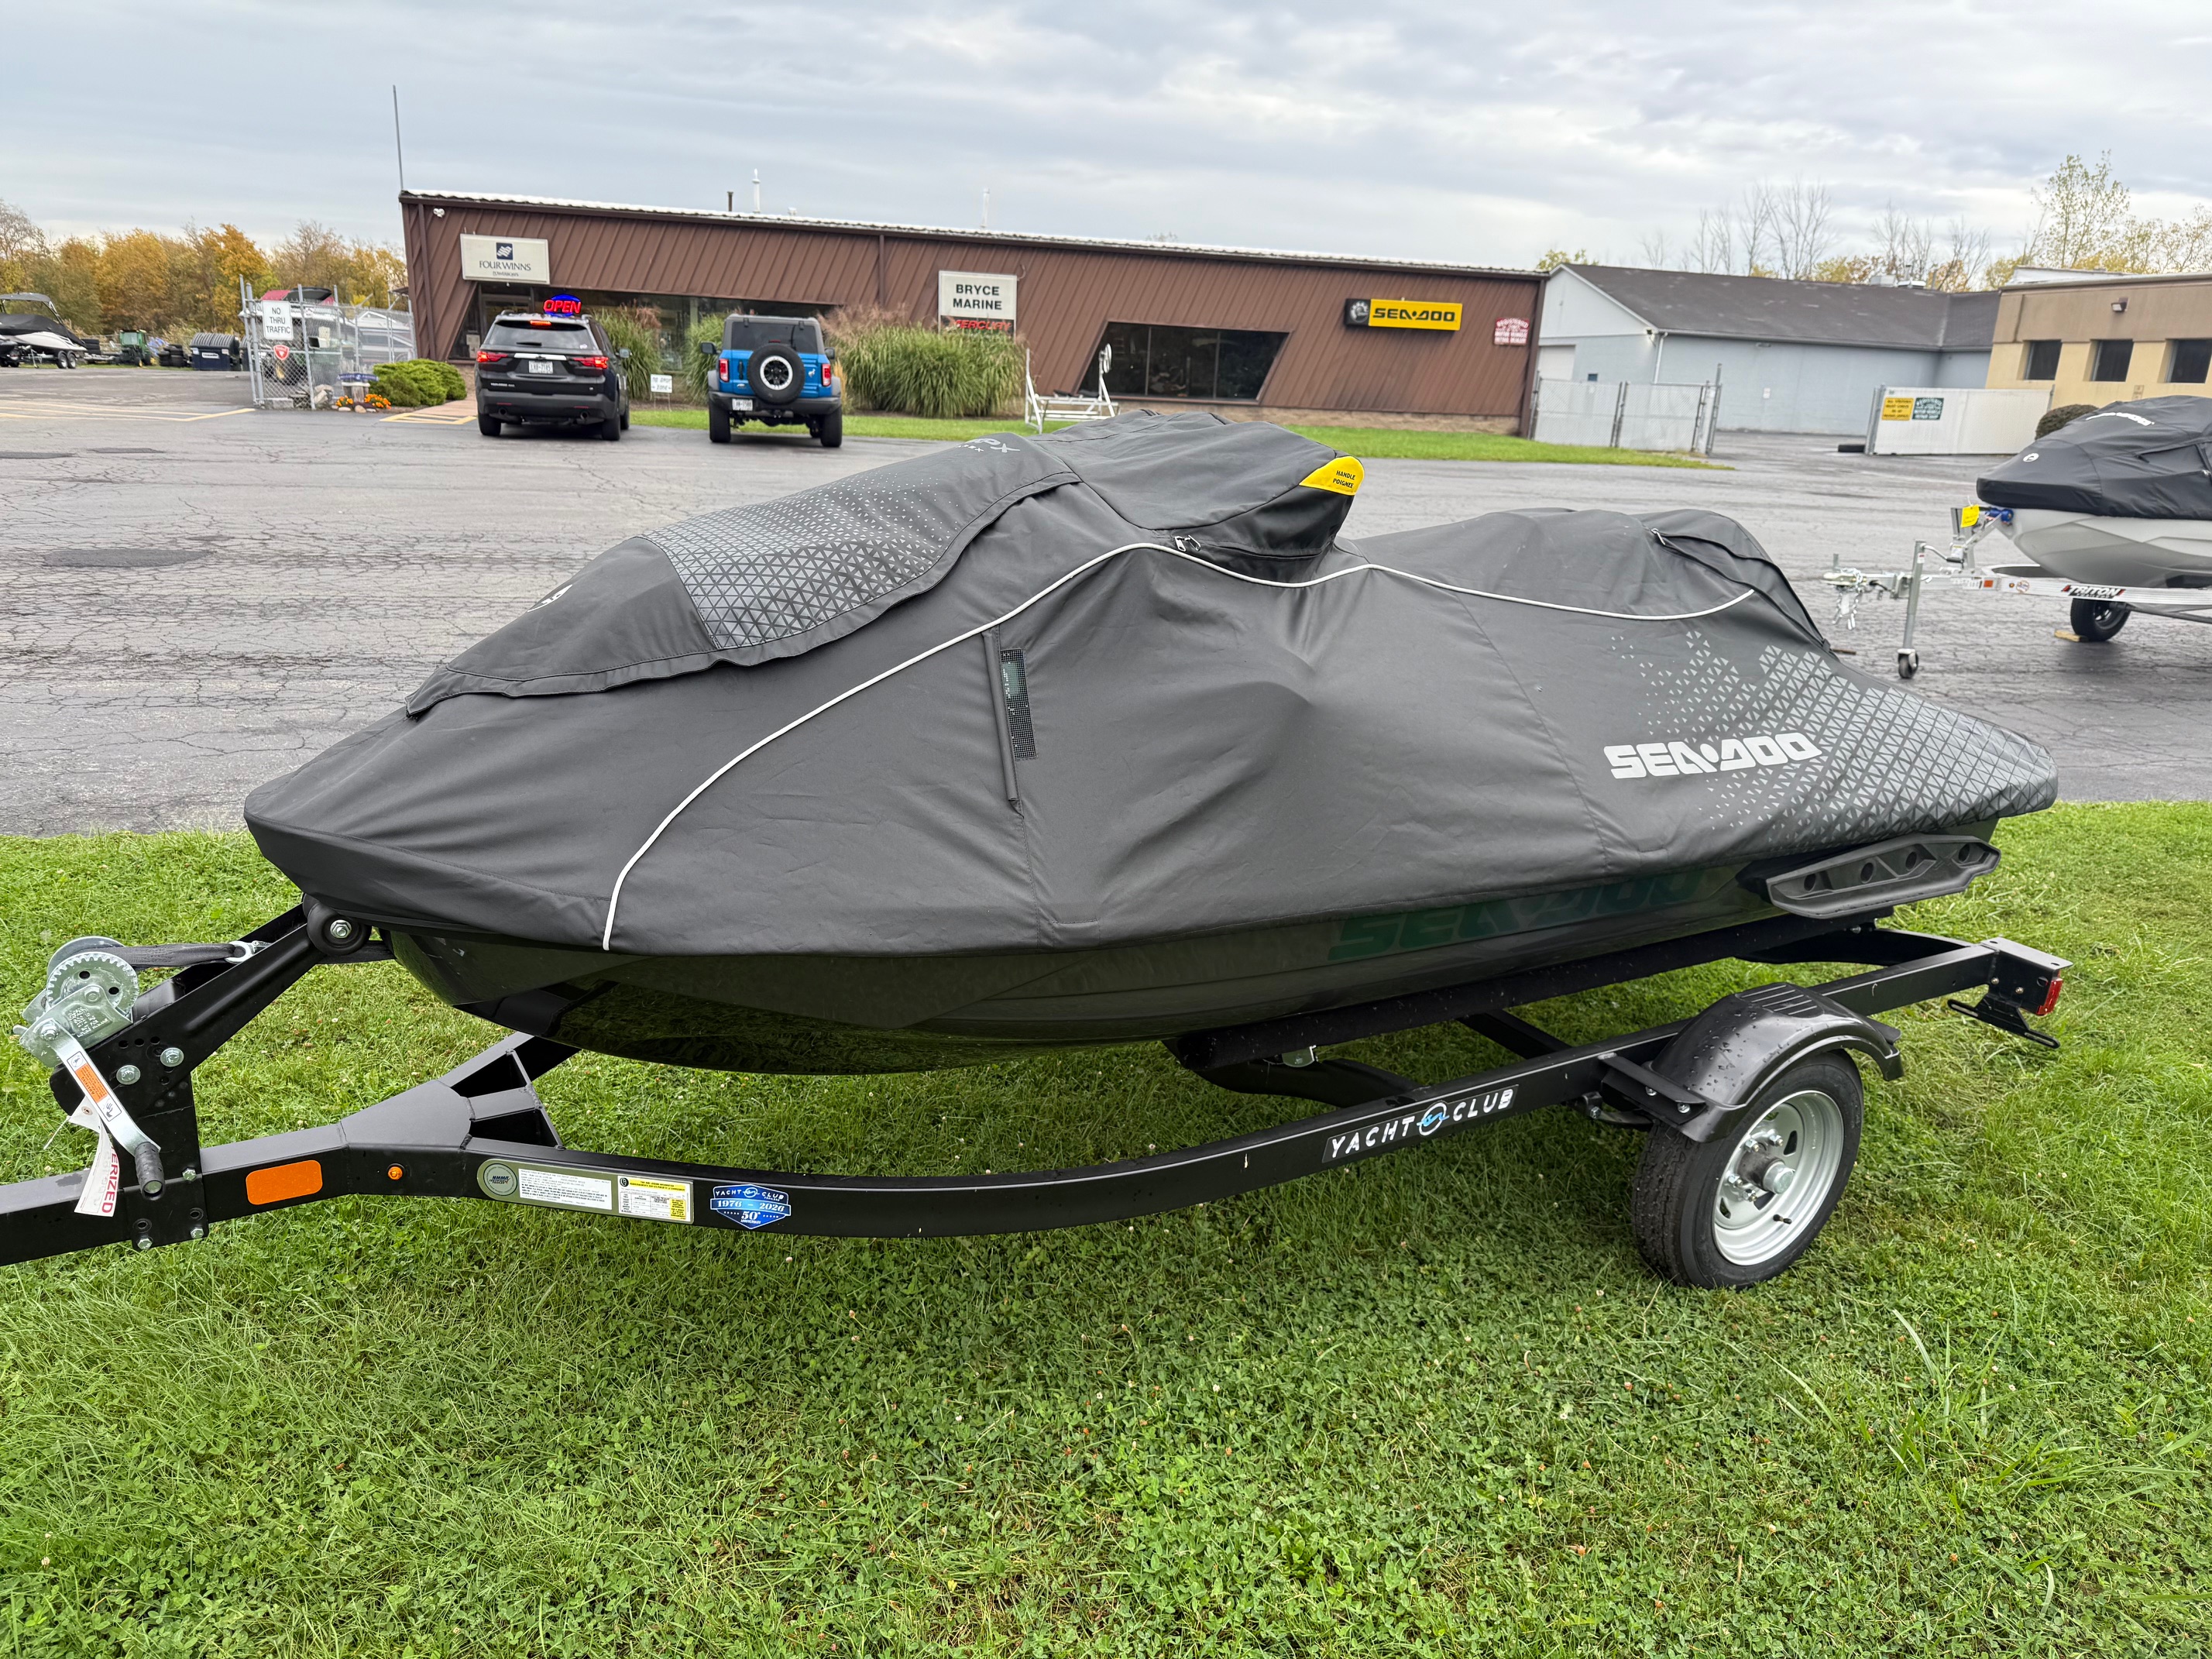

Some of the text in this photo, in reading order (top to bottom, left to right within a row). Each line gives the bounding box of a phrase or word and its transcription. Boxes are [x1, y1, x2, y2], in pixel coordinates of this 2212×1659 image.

[479, 260, 531, 271] FOUR WINNS
[956, 284, 1000, 296] BRYCE
[544, 300, 582, 313] OPEN
[953, 298, 1002, 310] MARINE
[266, 325, 290, 334] TRAFFIC
[1336, 470, 1355, 480] HANDLE
[2069, 586, 2121, 596] TRITON
[1332, 1089, 1513, 1159] YACHT CLUB
[102, 1146, 118, 1214] ERIZED
[759, 1202, 785, 1212] 2026
